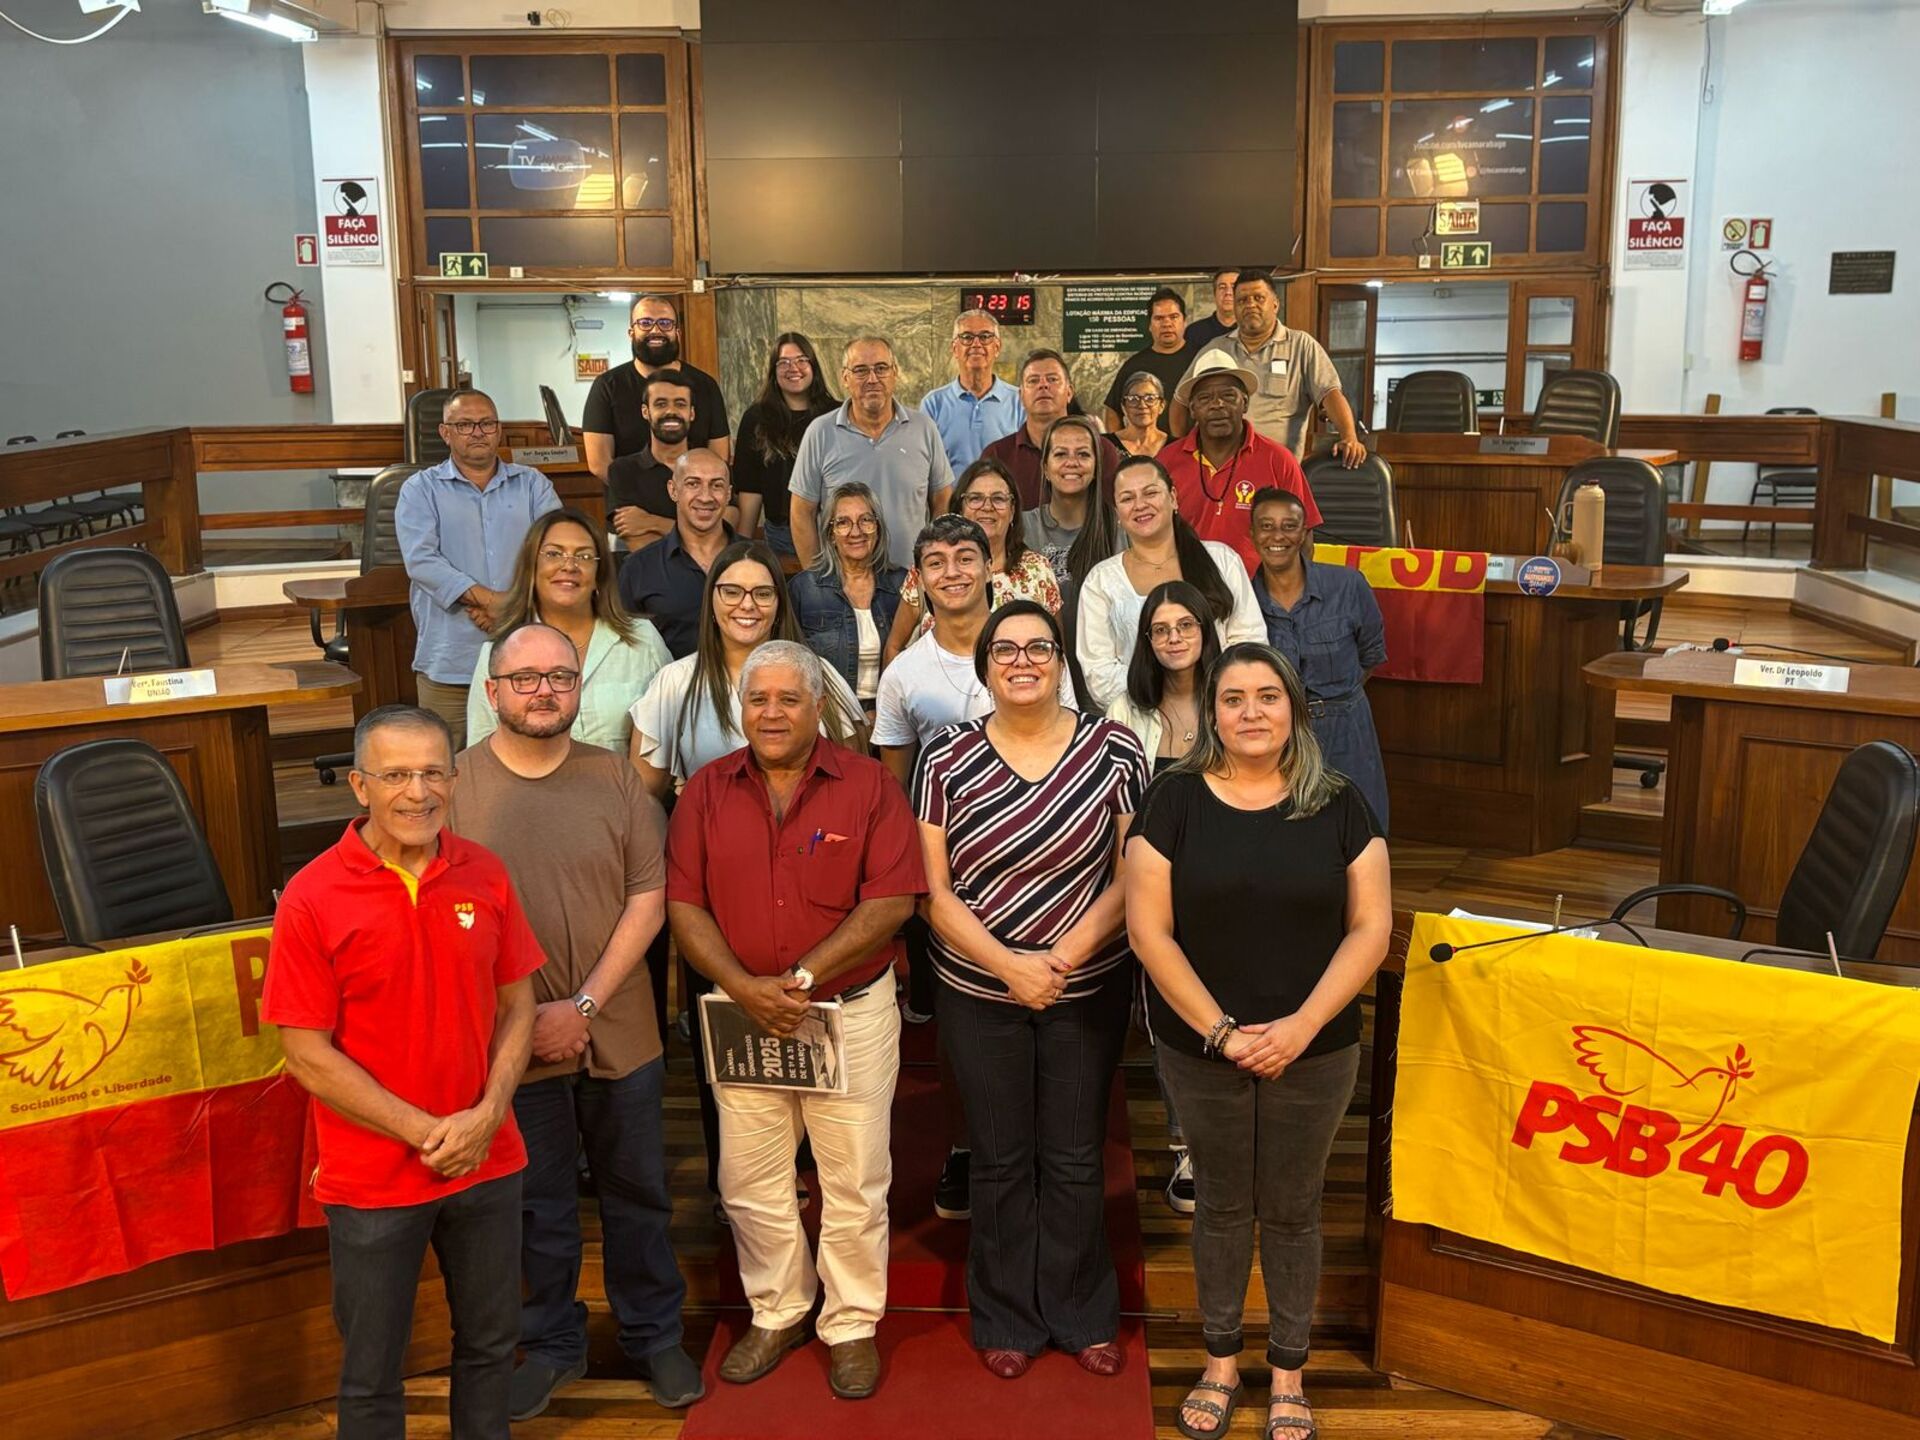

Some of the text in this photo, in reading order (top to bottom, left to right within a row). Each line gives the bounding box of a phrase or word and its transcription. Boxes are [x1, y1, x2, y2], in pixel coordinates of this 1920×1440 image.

[338, 218, 366, 231] FAÇA
[1642, 221, 1672, 234] FAÇA
[328, 231, 378, 244] SILÊNCIO
[1629, 234, 1682, 248] SILÊNCIO
[988, 294, 1008, 310] 23
[1017, 294, 1030, 310] 15
[1760, 665, 1774, 674] Ver.
[1786, 668, 1822, 678] Leopoldo
[152, 678, 183, 686] Faustina
[1785, 678, 1795, 686] PT
[454, 902, 474, 912] PSB
[760, 1037, 784, 1078] 2025
[798, 1042, 807, 1080] DE MARÇO
[789, 1068, 796, 1078] DE
[10, 1074, 172, 1114] Socialismo e Liberdade
